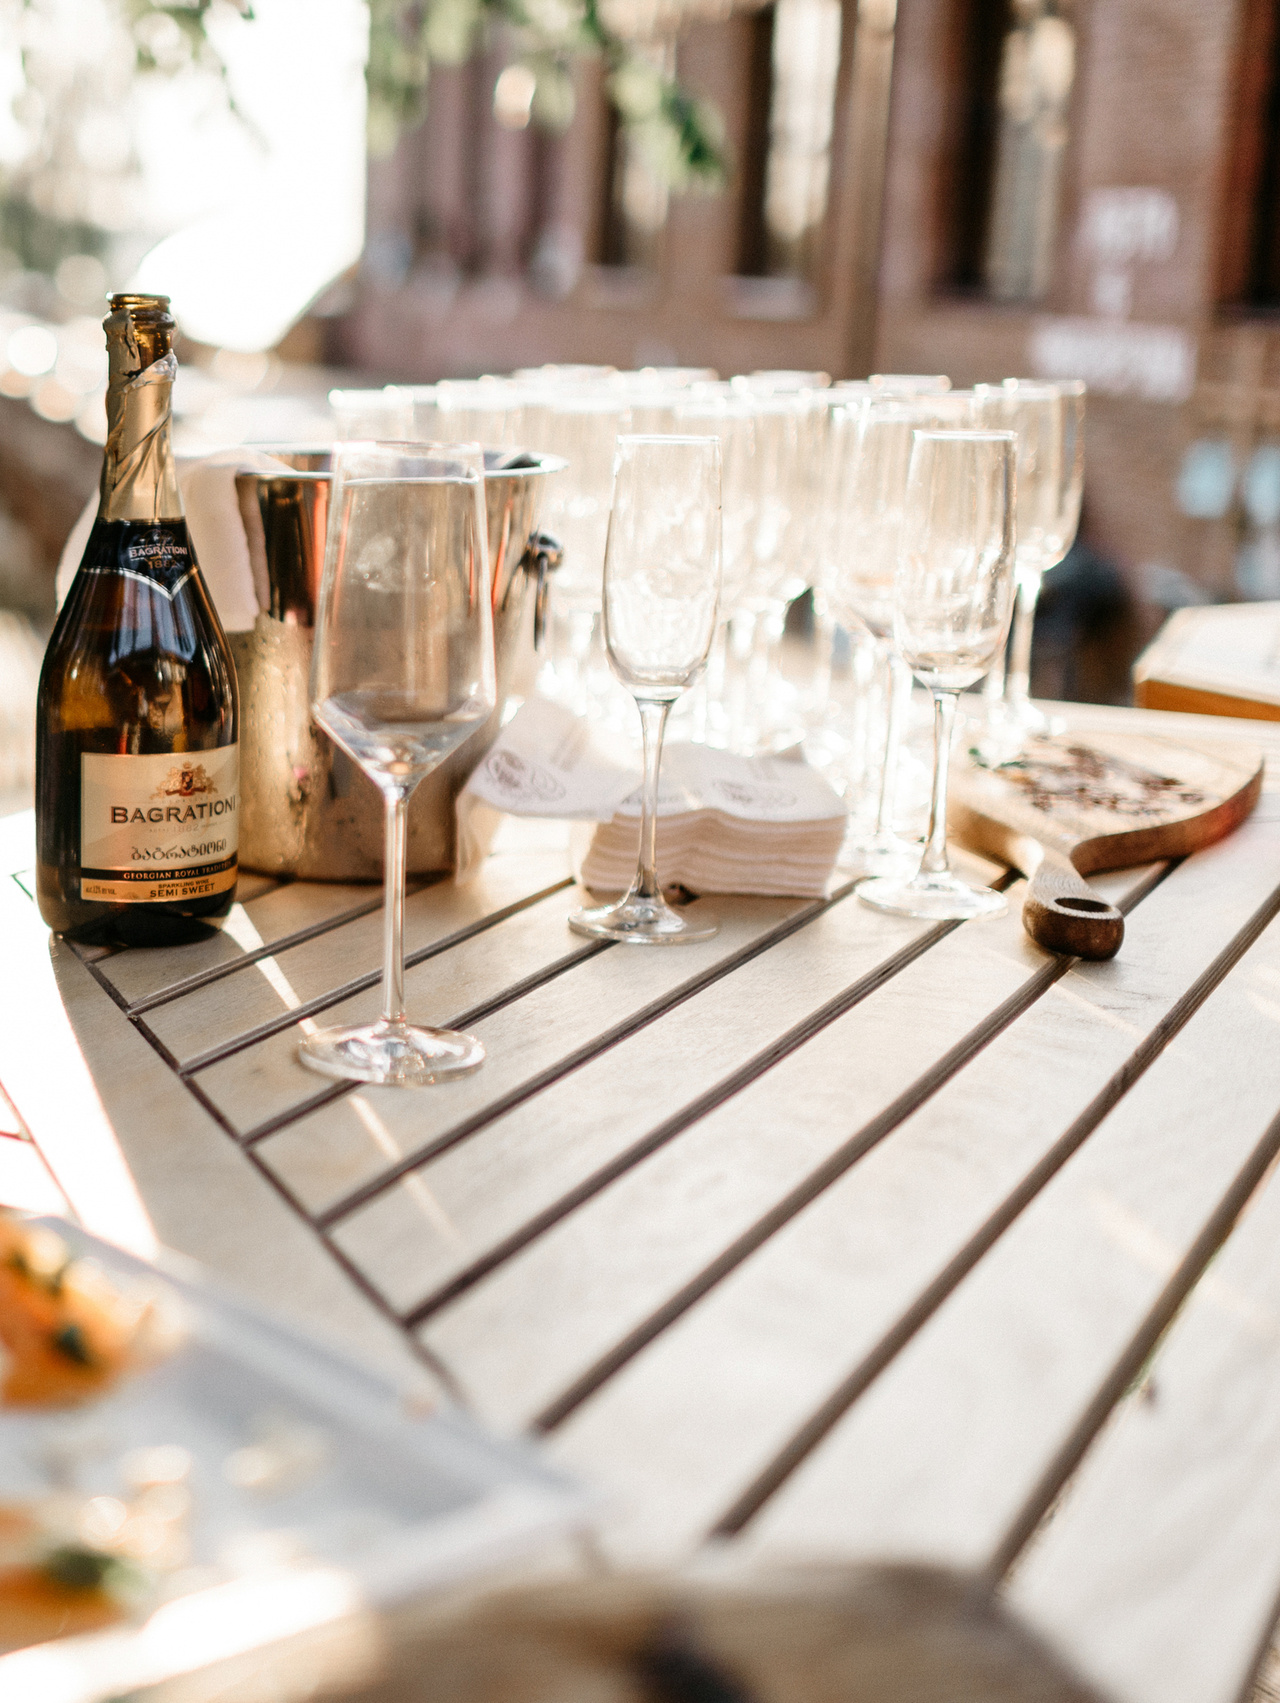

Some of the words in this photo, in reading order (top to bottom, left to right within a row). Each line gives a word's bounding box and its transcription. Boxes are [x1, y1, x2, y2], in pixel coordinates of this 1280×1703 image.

[129, 546, 188, 558] BAGRATIONI
[110, 795, 236, 824] BAGRATIONI
[123, 871, 172, 880] GEORGIAN
[175, 869, 200, 879] ROYAL
[150, 888, 178, 898] SEMI
[182, 882, 215, 896] SWEET
[158, 881, 195, 889] SPARKLING
